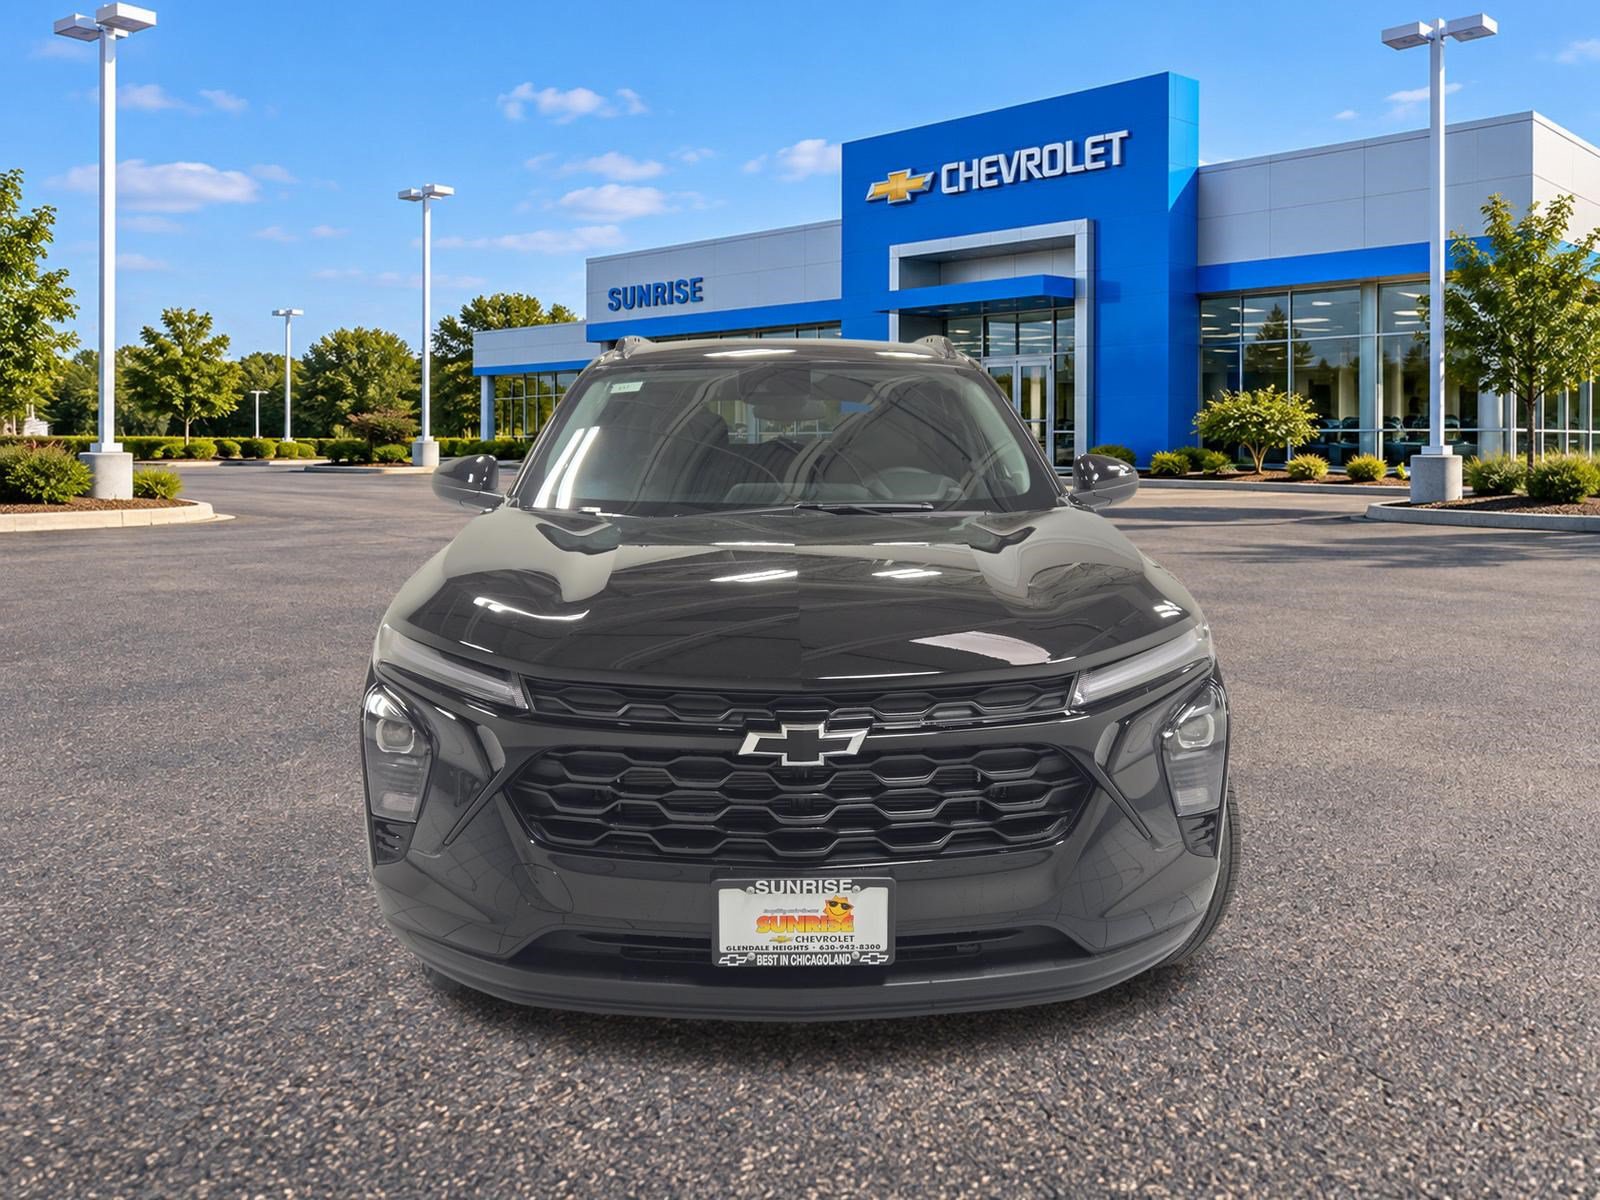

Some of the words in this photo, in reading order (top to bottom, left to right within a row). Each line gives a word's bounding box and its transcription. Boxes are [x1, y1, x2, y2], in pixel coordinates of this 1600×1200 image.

[940, 129, 1129, 194] CHEVROLET
[608, 277, 704, 312] SUNRISE
[755, 879, 853, 894] SUNRISE
[755, 915, 855, 933] SUNRISE
[795, 935, 855, 943] CHEVROLET
[819, 943, 881, 951] 630-942-8300
[756, 954, 779, 966] BEST
[780, 954, 789, 966] IN
[790, 953, 851, 966] CHICAGOLAND
